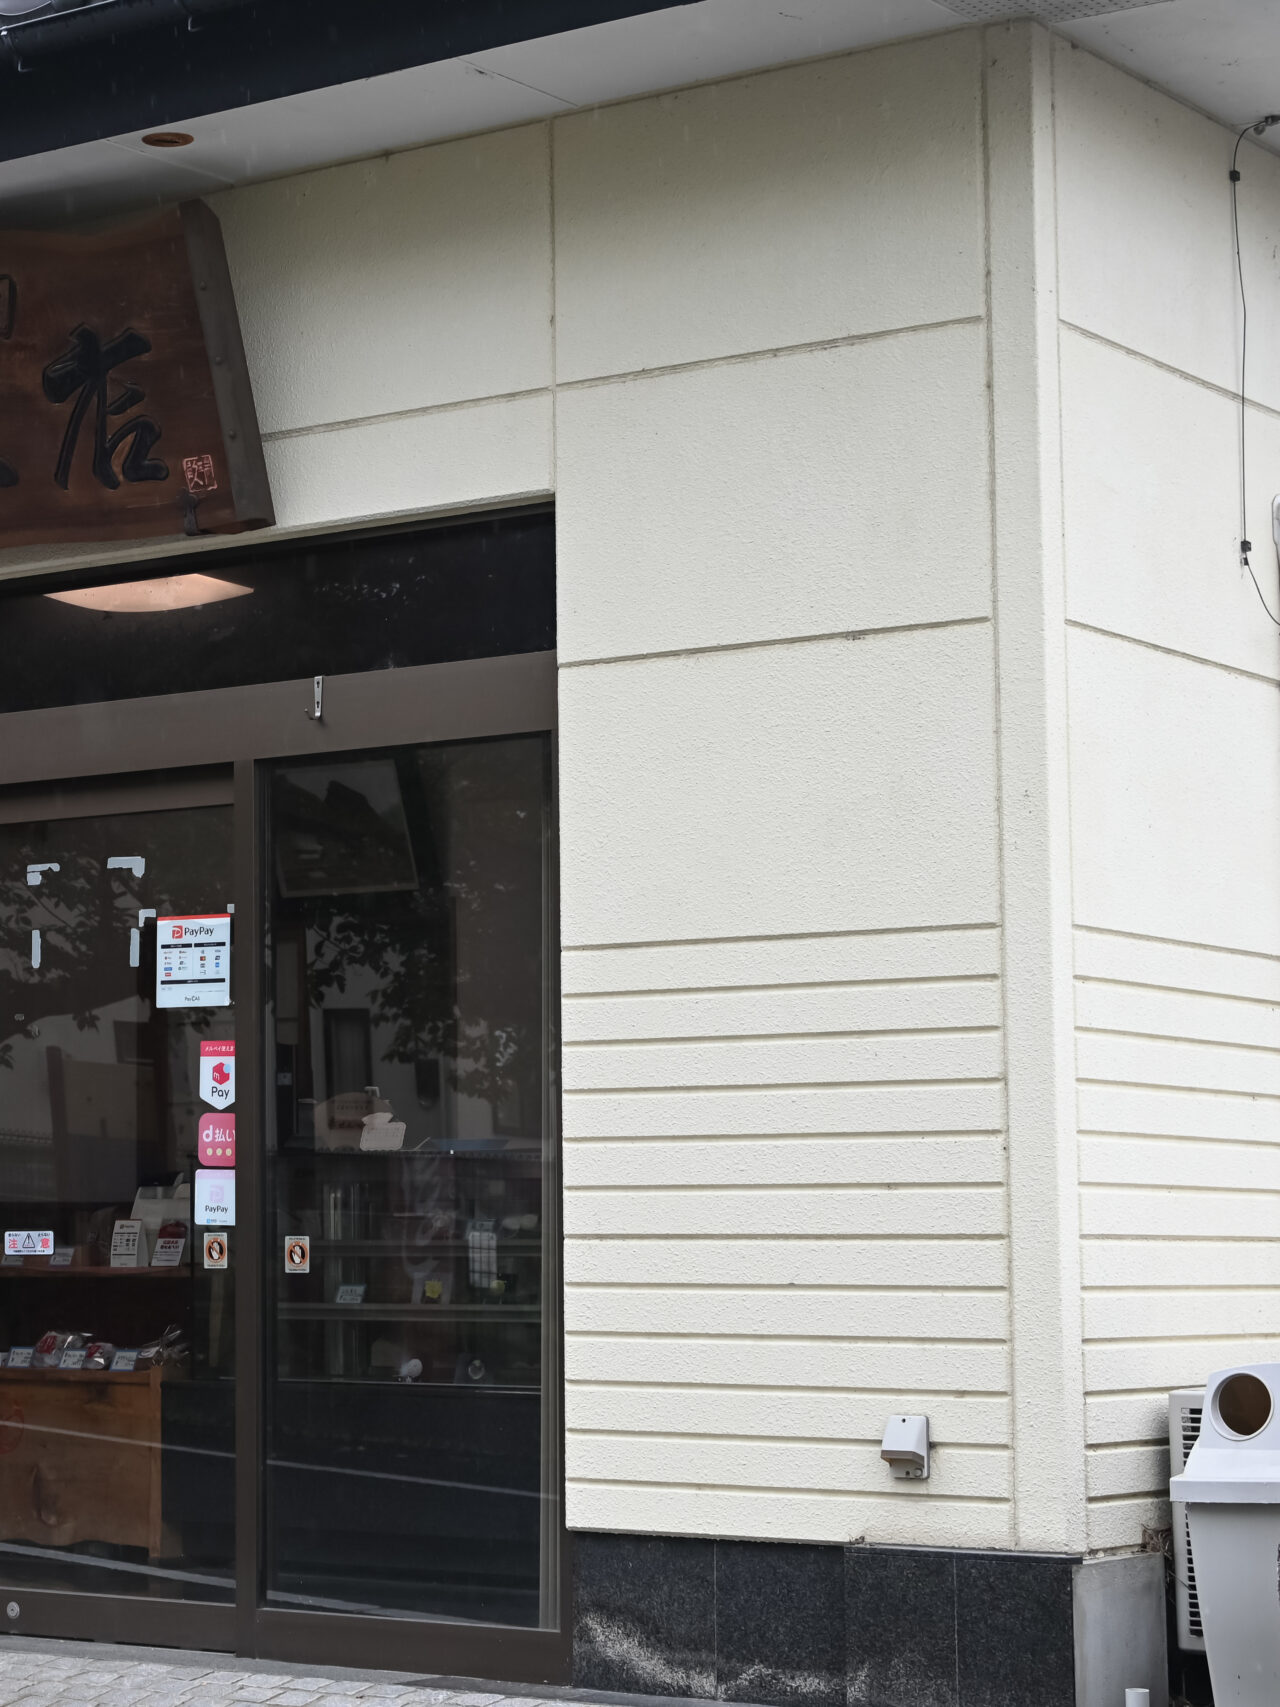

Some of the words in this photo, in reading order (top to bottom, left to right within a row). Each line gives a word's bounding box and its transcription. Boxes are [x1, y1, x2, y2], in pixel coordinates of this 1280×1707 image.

[184, 926, 215, 937] PayPay
[211, 1086, 230, 1100] Pay
[204, 1204, 229, 1214] PayPay
